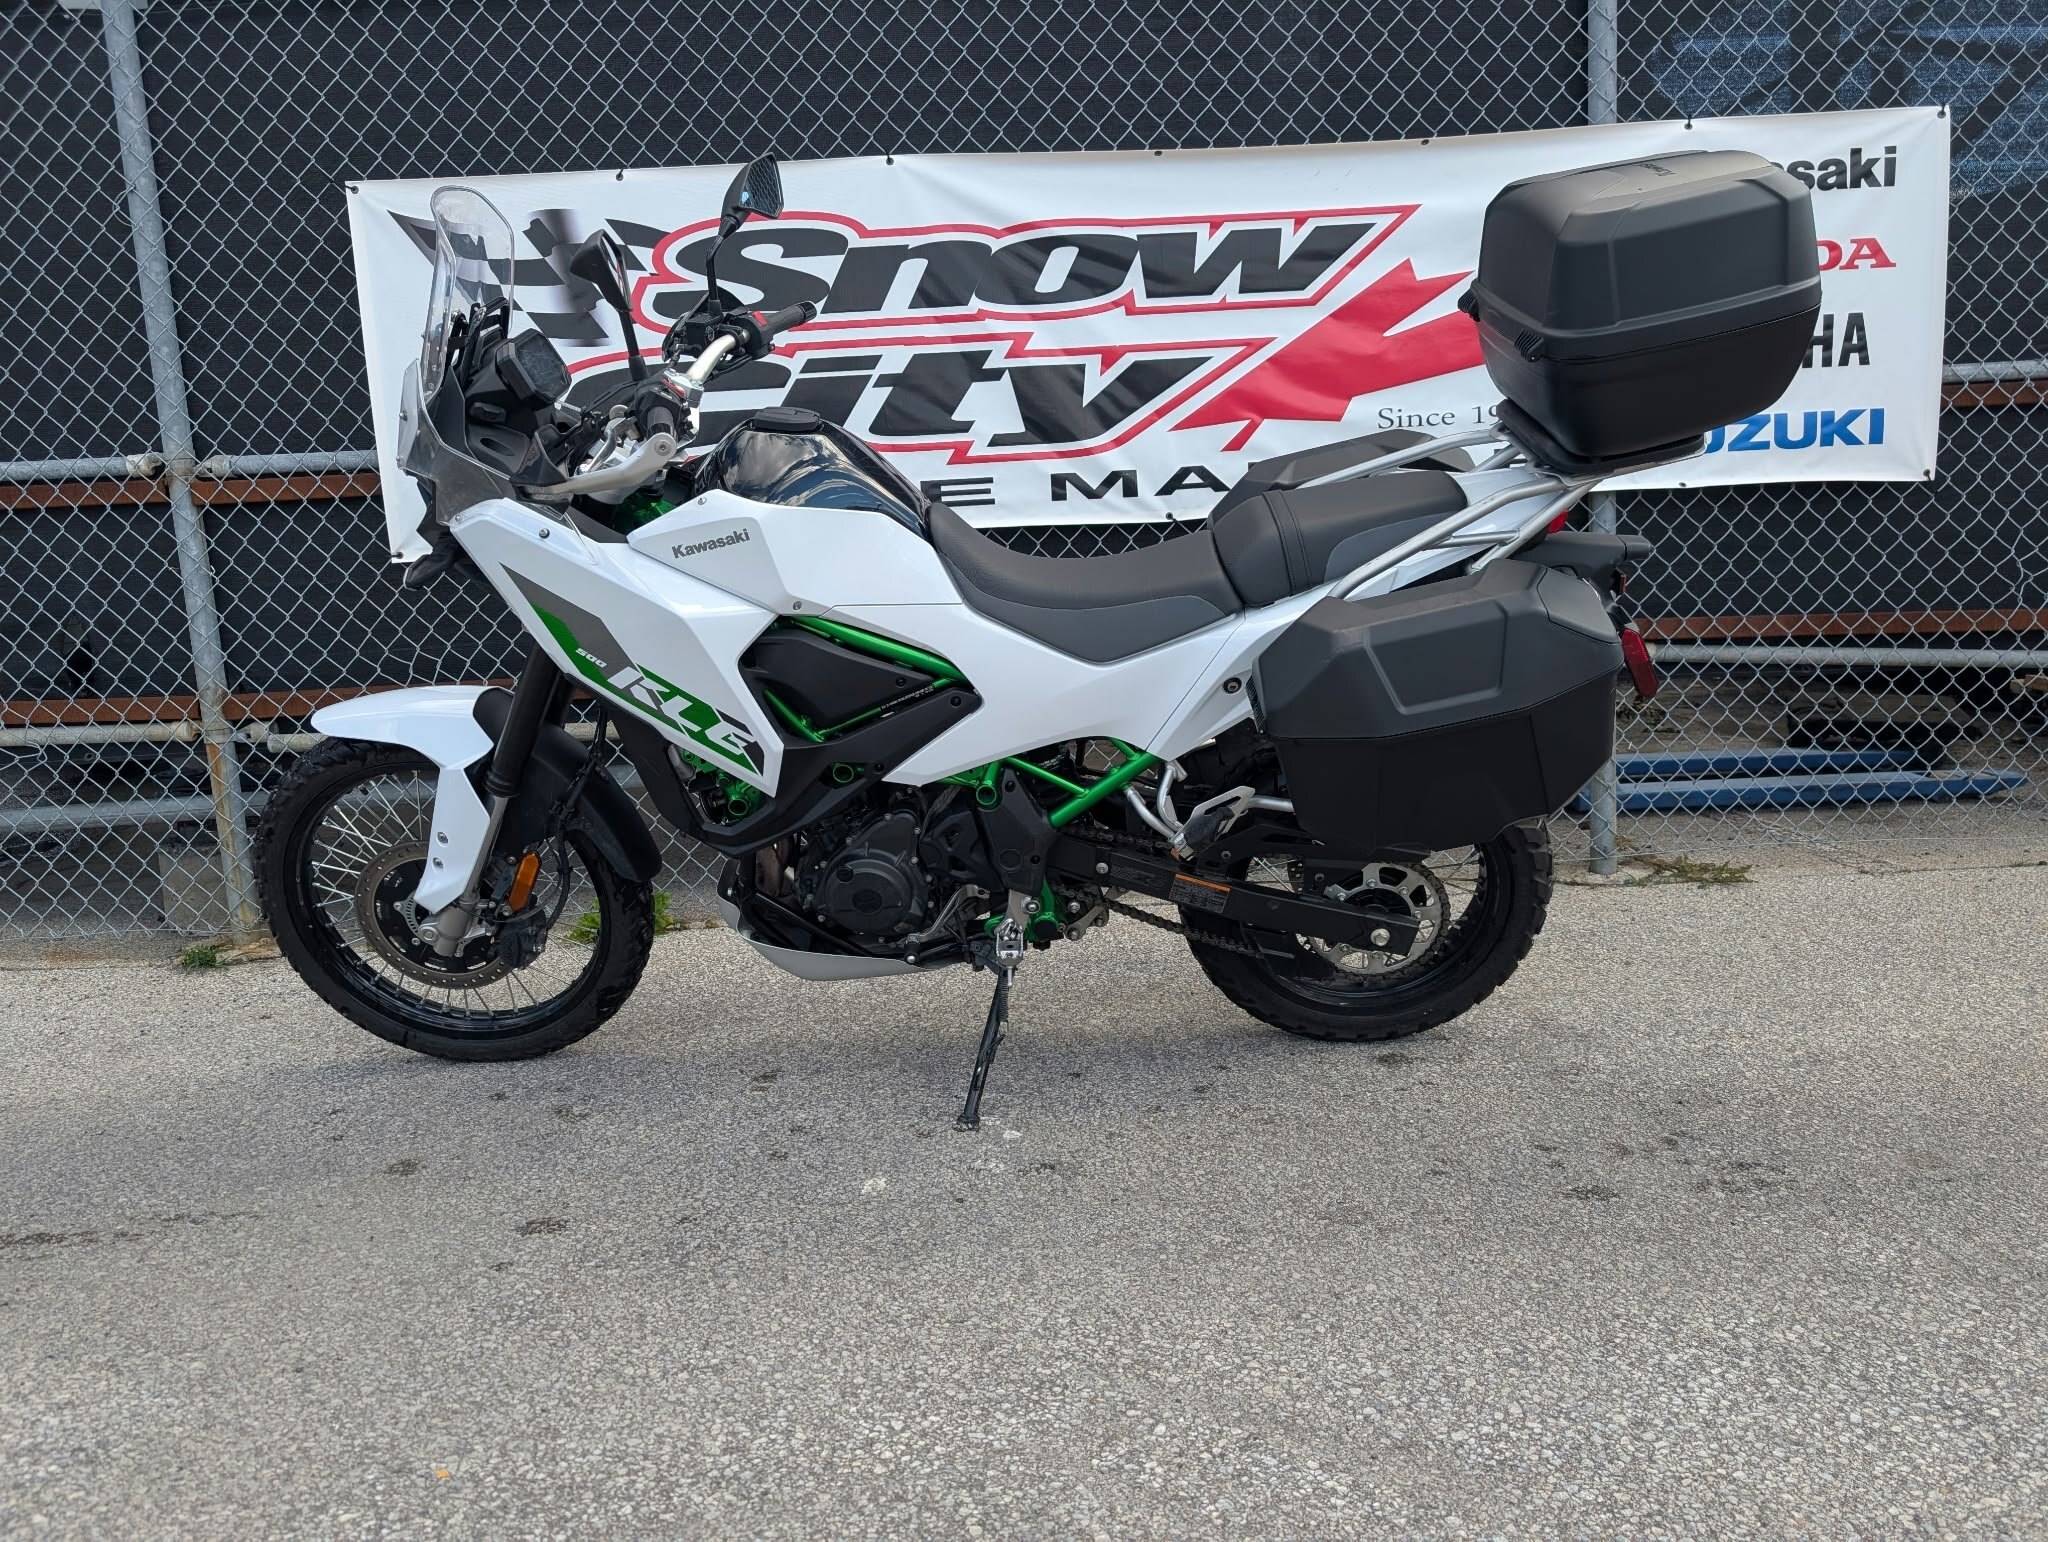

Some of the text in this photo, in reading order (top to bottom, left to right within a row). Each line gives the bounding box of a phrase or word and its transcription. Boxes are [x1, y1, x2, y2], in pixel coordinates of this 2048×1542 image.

[1770, 146, 1896, 191] saki
[652, 222, 1377, 313] Snow
[1377, 407, 1455, 429] Since
[1705, 408, 1884, 454] ZUKI
[671, 528, 751, 559] Kawasaki
[575, 648, 608, 669] 500
